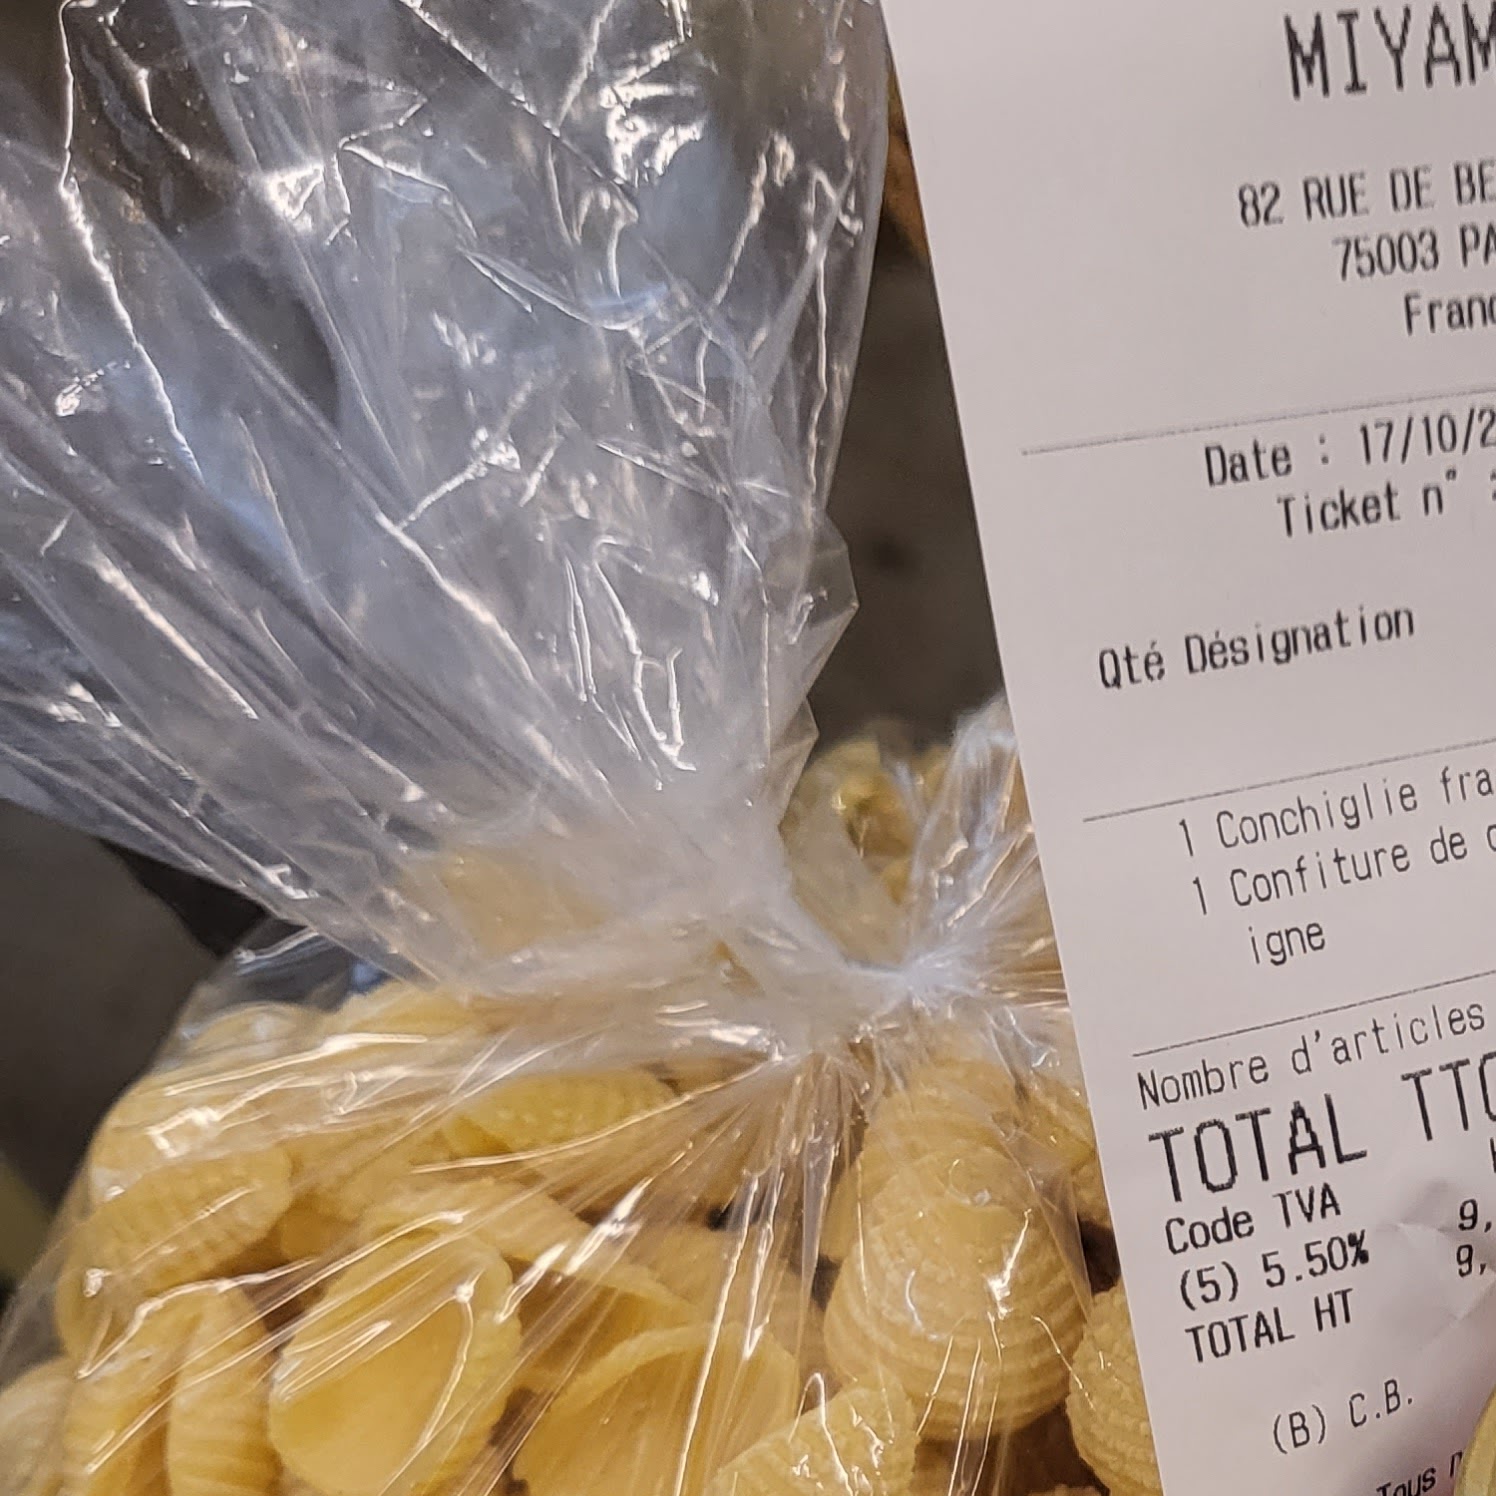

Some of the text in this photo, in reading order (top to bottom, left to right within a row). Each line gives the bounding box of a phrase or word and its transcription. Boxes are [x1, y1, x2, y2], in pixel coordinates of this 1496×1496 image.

[1239, 183, 1282, 227] 82
[1303, 171, 1370, 221] RUE
[1390, 167, 1434, 213] DE
[1334, 229, 1440, 281] 75003
[1205, 440, 1291, 486] Date
[1278, 482, 1400, 537] Ticket
[1099, 610, 1413, 689] Qté Désignation
[1179, 819, 1193, 856] 1
[1217, 783, 1417, 857] Conchiglie
[1193, 877, 1207, 915] 1
[1230, 845, 1410, 906] Confiture
[1430, 826, 1467, 864] de
[1249, 923, 1325, 966] igne
[1133, 1048, 1268, 1110] Nombre
[1292, 993, 1484, 1075] d'articles
[1149, 1094, 1367, 1202] TOTAL
[1165, 1207, 1254, 1255] Code
[1273, 1183, 1341, 1228] TVA
[1180, 1261, 1238, 1311] (5)
[1262, 1230, 1369, 1288] 5.50%
[1185, 1307, 1295, 1362] TOTAL
[1314, 1288, 1352, 1332] HT
[1273, 1379, 1412, 1454] (B) C.B.
